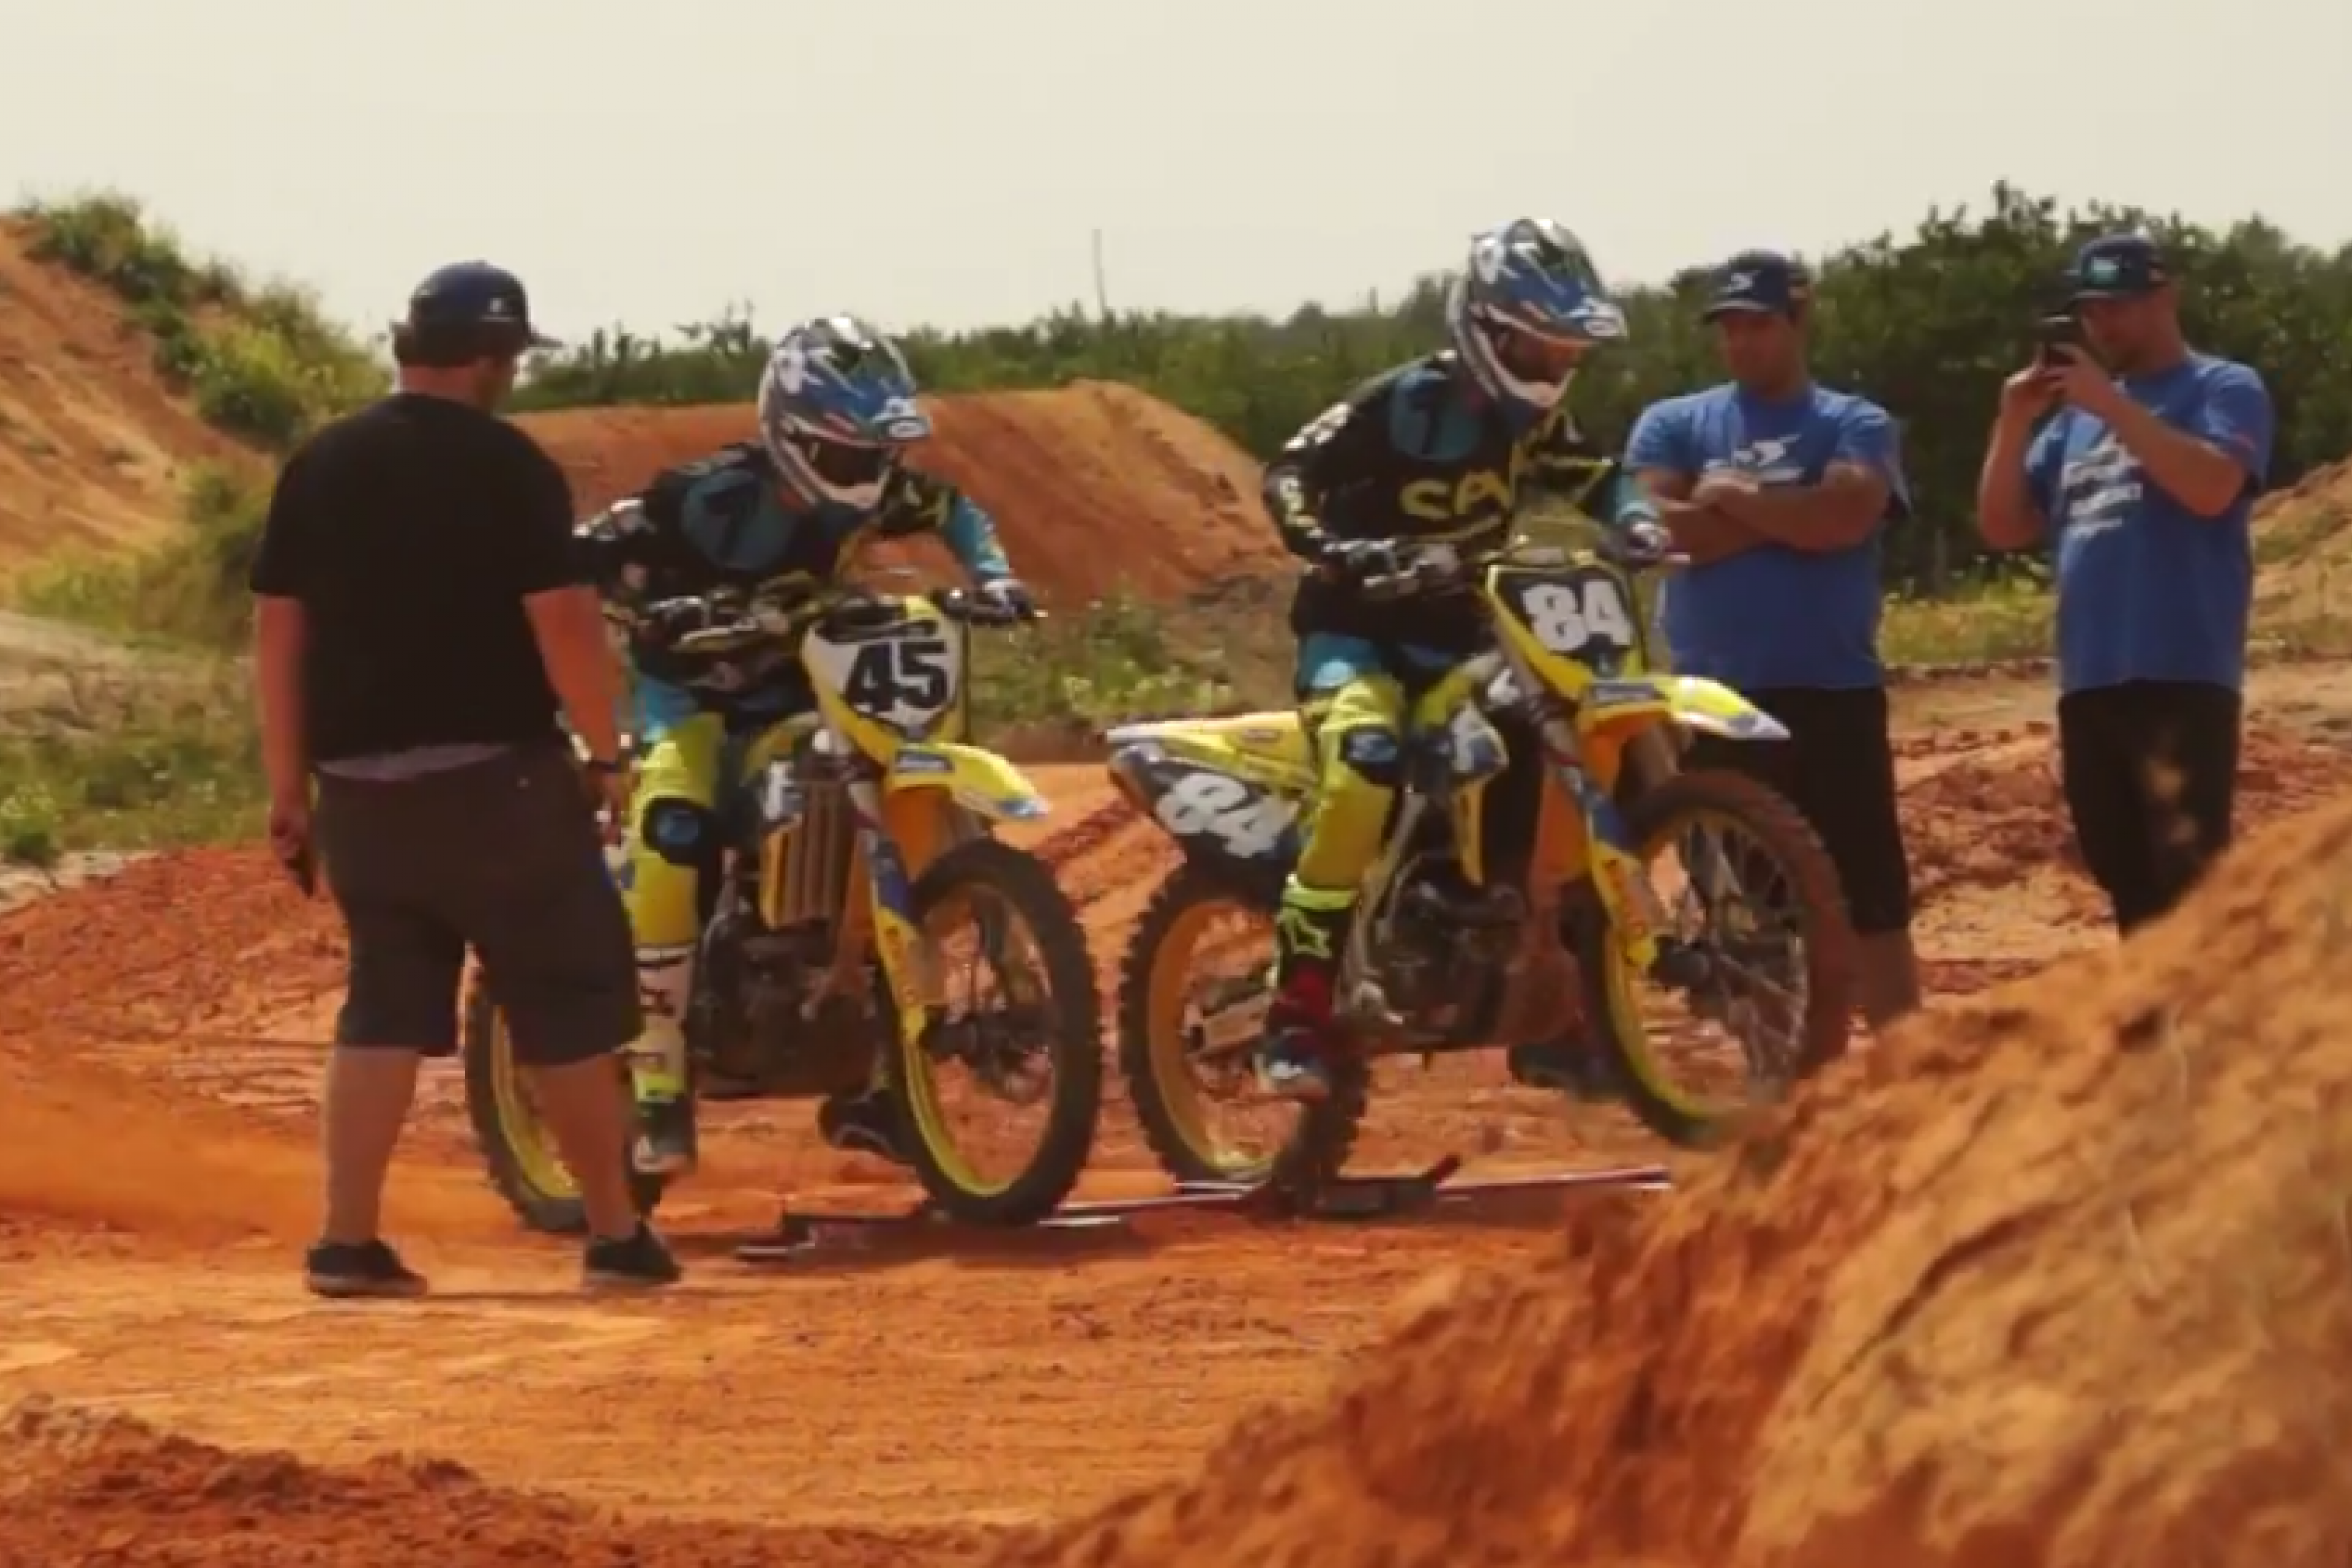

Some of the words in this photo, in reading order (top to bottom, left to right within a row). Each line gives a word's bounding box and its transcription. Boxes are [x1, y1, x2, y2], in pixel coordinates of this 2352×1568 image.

[1522, 580, 1633, 652] 84
[845, 639, 948, 712] 45
[1156, 772, 1301, 858] 84
